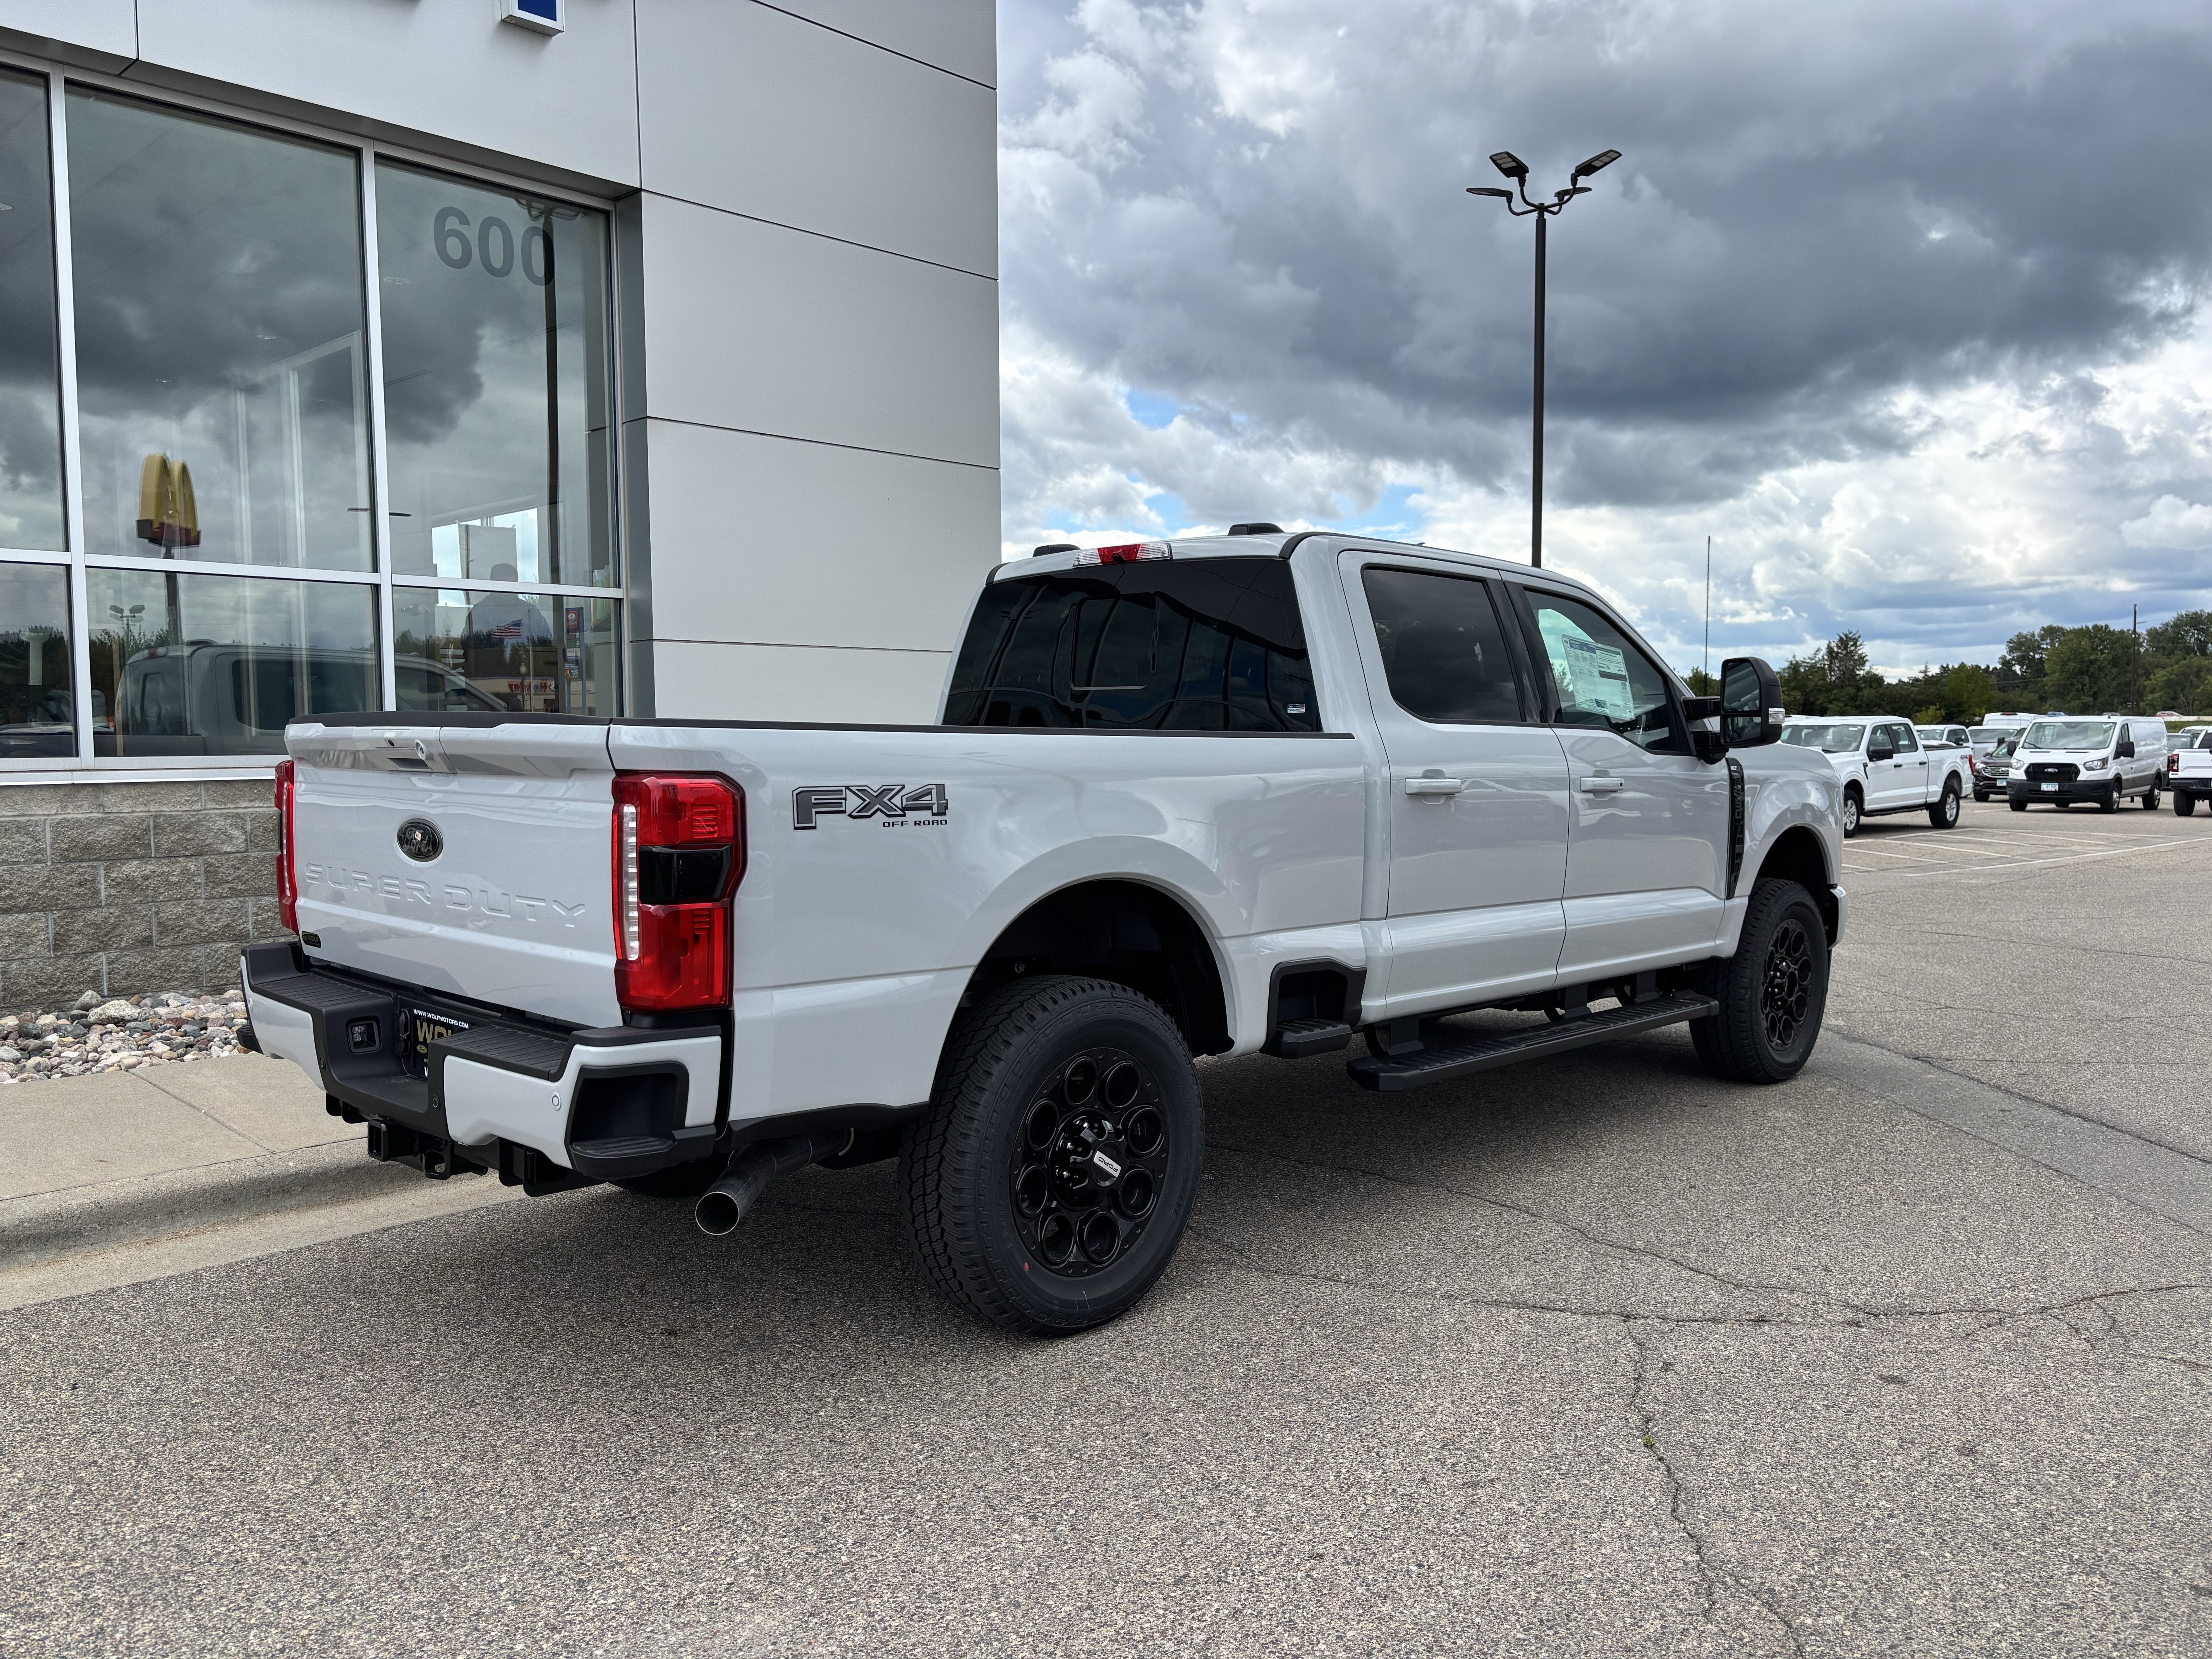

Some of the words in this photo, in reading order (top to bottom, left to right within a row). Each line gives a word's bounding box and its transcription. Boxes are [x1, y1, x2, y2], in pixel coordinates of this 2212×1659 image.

[433, 206, 555, 286] 600
[792, 783, 949, 830] FX4
[306, 863, 431, 905] SUPER
[444, 884, 586, 927] DUTY
[413, 1008, 469, 1029] WWW.WOLFMOTORS.COM
[1098, 1156, 1118, 1173] FORD
